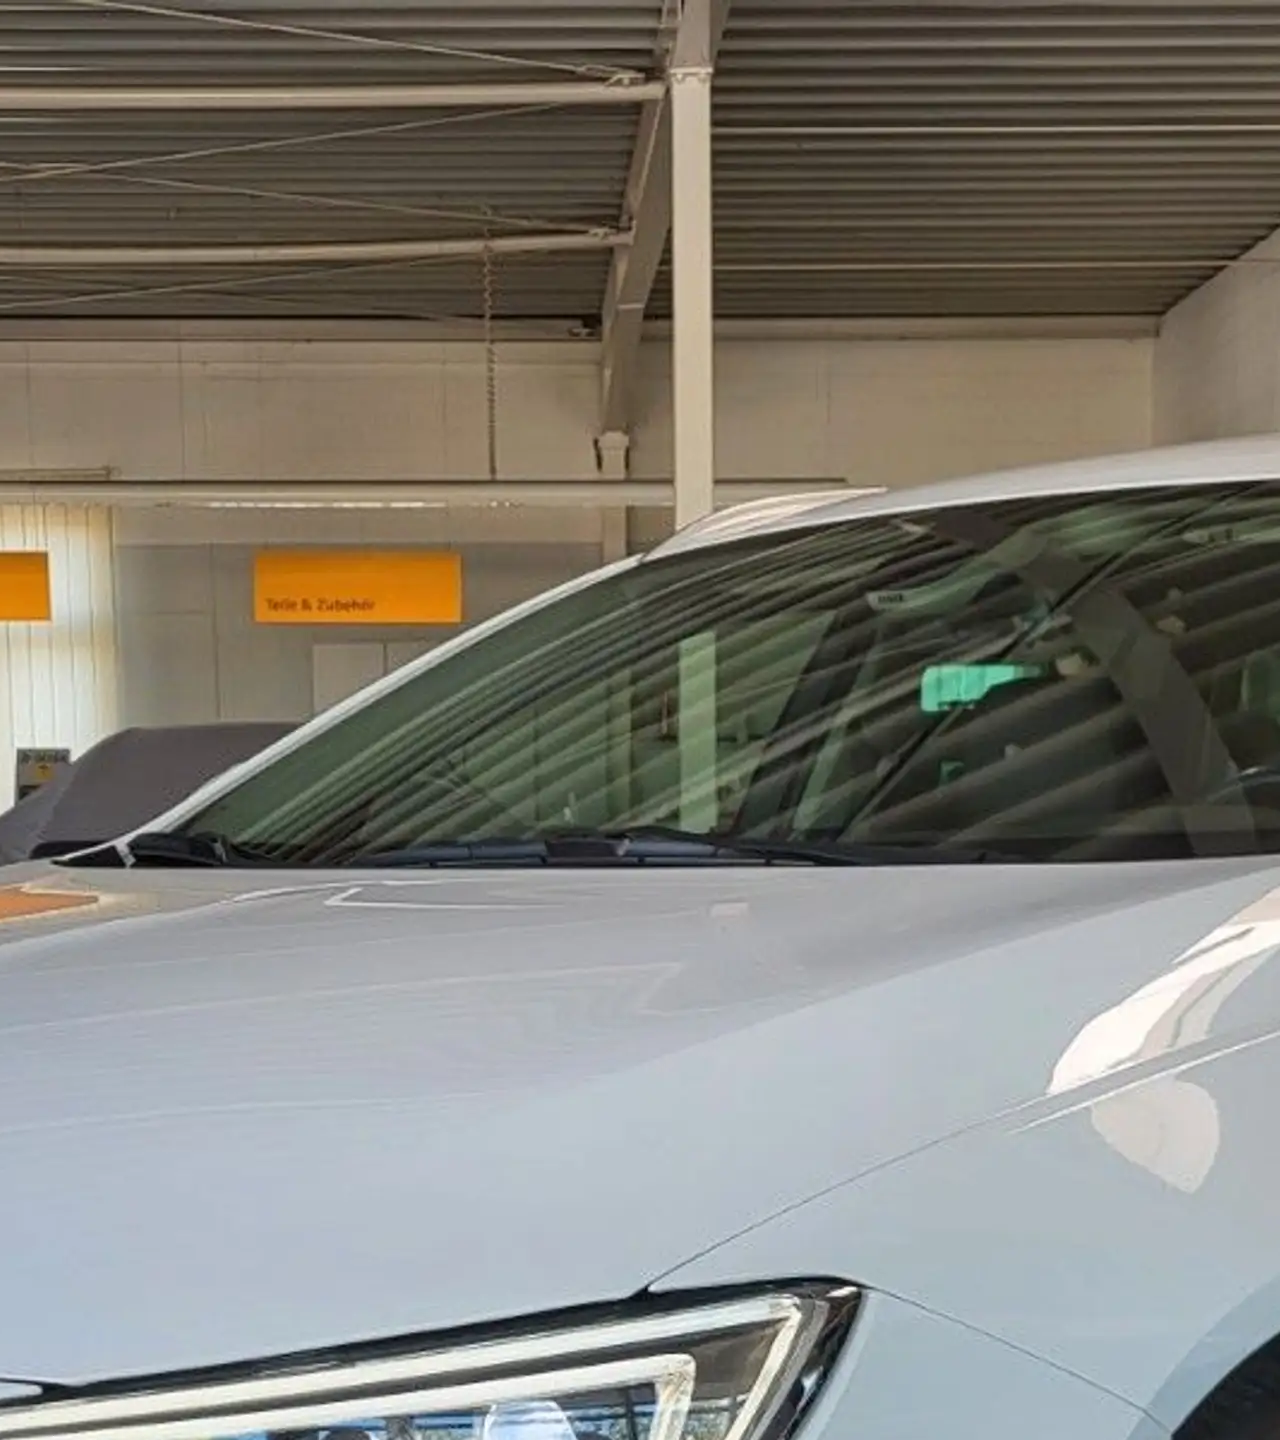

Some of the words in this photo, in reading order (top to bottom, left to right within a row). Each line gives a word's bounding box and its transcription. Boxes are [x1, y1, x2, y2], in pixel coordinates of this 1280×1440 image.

[265, 597, 298, 612] Teile
[301, 598, 312, 611] &
[316, 597, 376, 612] Zubehör
